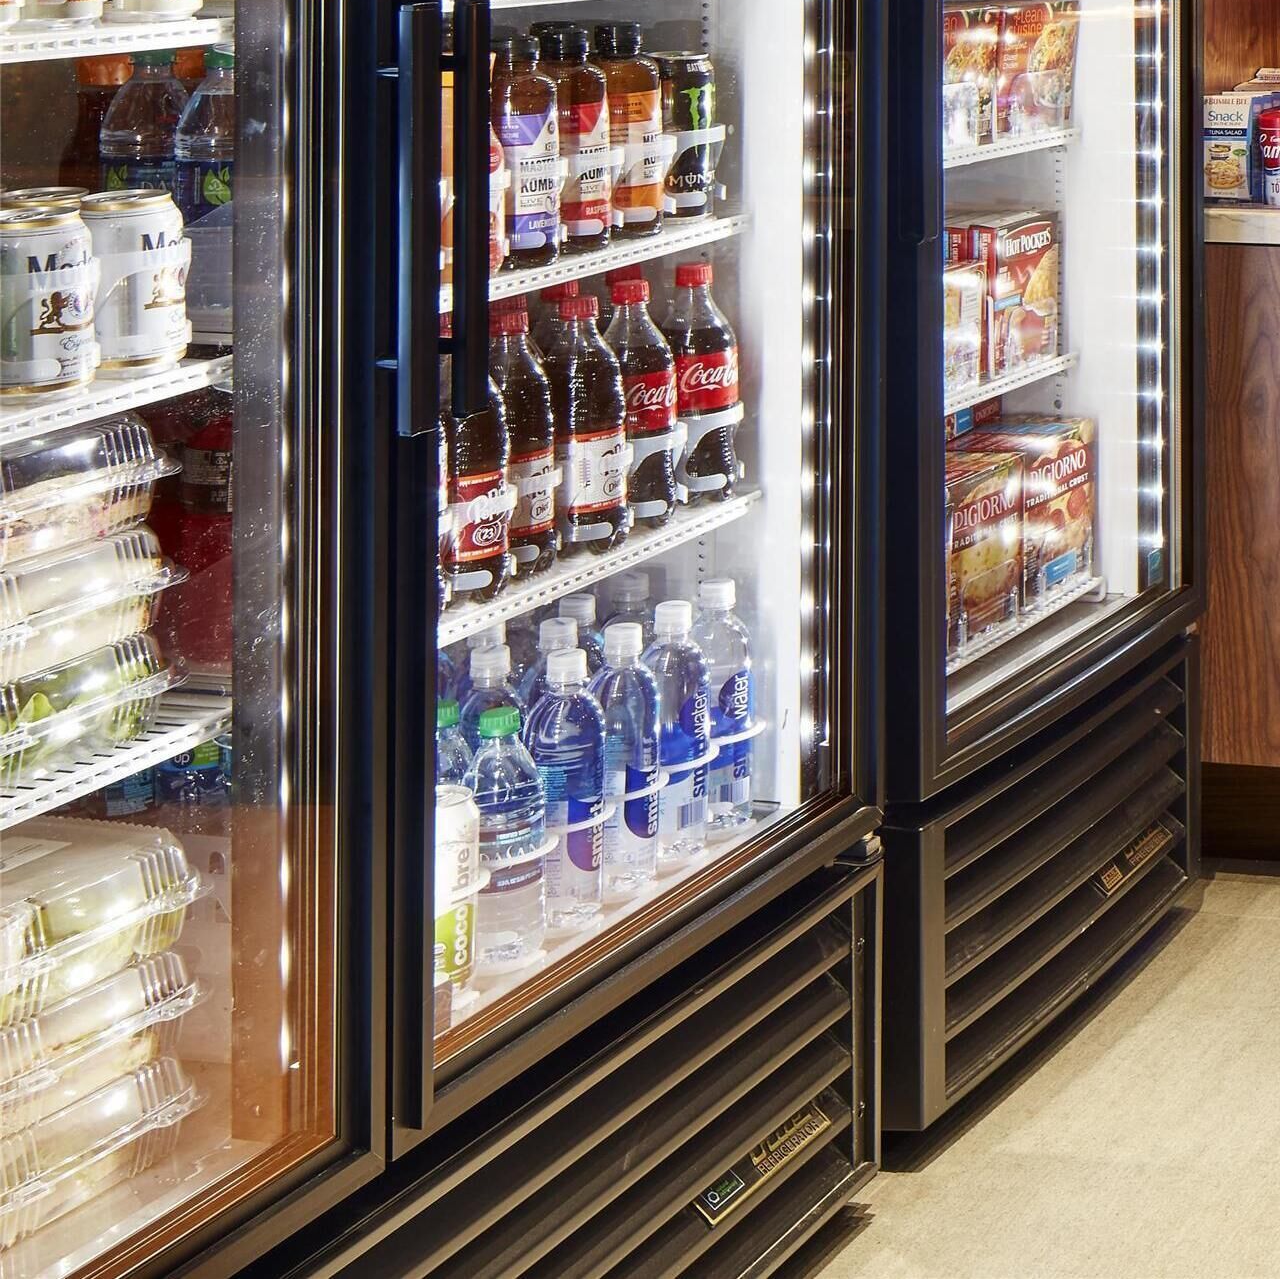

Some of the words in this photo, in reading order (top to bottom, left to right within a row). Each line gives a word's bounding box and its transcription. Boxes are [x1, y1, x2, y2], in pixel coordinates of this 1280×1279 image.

[1020, 8, 1043, 23] Lean
[1207, 110, 1244, 122] Snack
[1070, 473, 1089, 488] CRUST
[454, 906, 469, 966] coco
